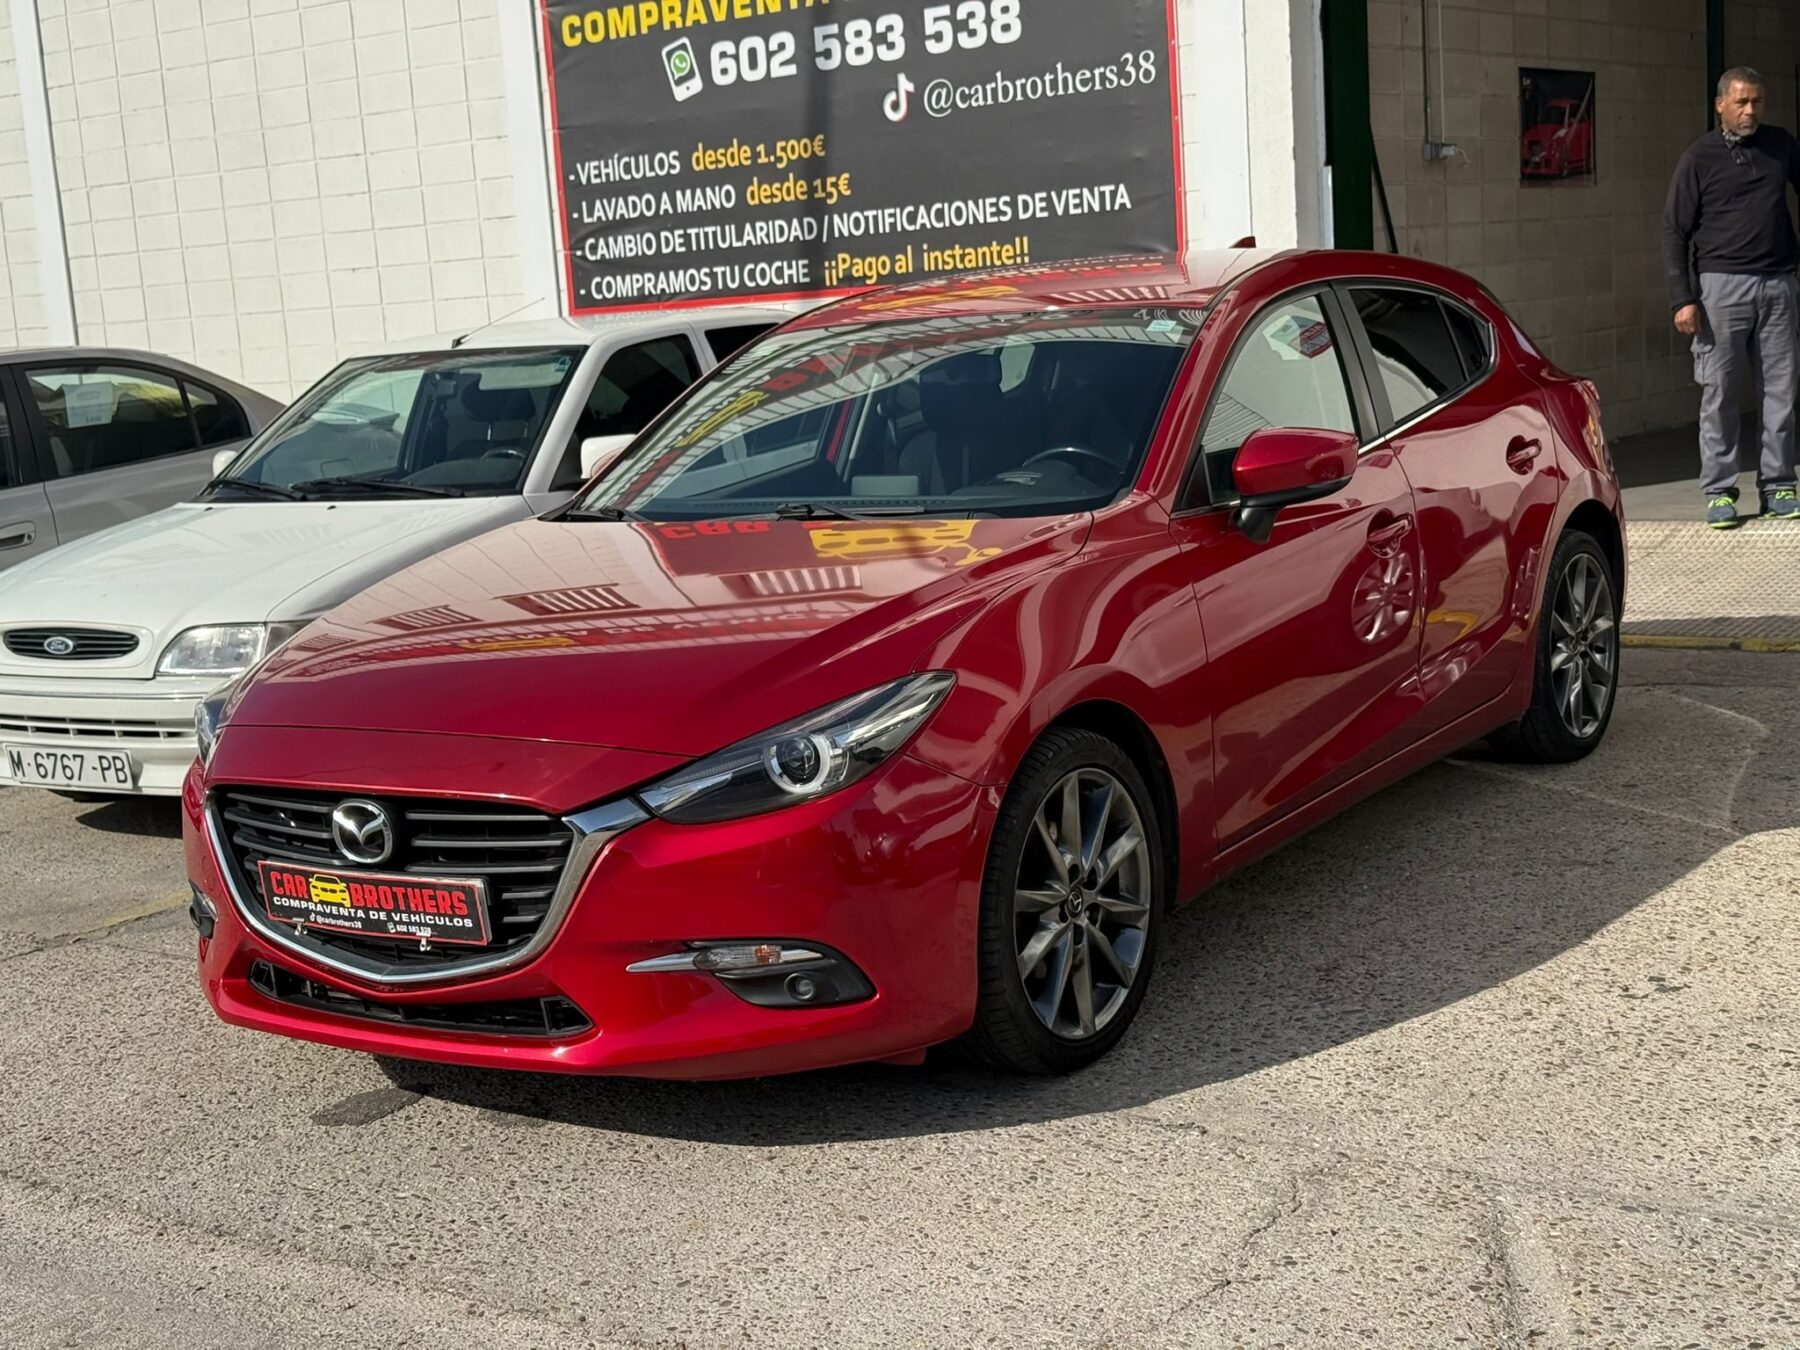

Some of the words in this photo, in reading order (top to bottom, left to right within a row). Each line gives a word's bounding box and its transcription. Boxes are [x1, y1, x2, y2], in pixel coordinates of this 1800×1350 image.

[561, 0, 829, 47] COMPRAVE
[710, 30, 797, 86] 602
[813, 13, 906, 71] 583
[923, 0, 1022, 55] 538
[923, 50, 1156, 118] @carbrothers38
[691, 138, 751, 172] desde
[756, 134, 825, 168] 1.500€
[582, 192, 656, 224] LAVADO
[659, 191, 674, 215] A
[676, 184, 736, 214] MANO
[747, 172, 807, 206] desde
[813, 173, 851, 205] 15€
[661, 229, 686, 254] DE
[687, 216, 817, 251] TITULARIDAD
[833, 195, 1012, 239] NOTIFICACIONES
[1018, 194, 1049, 220] DE
[1050, 183, 1132, 216] VENTA
[591, 266, 711, 300] COMPRAMOS
[713, 265, 739, 291] TU
[743, 259, 810, 288] COCHE
[895, 245, 913, 275] al
[923, 236, 1030, 272] instante!!
[270, 871, 309, 899] CAR
[349, 883, 469, 916] BROTHERS
[273, 896, 365, 920] COMPRAVENTA
[369, 910, 388, 921] DE
[393, 910, 473, 928] VEHÍCULOS
